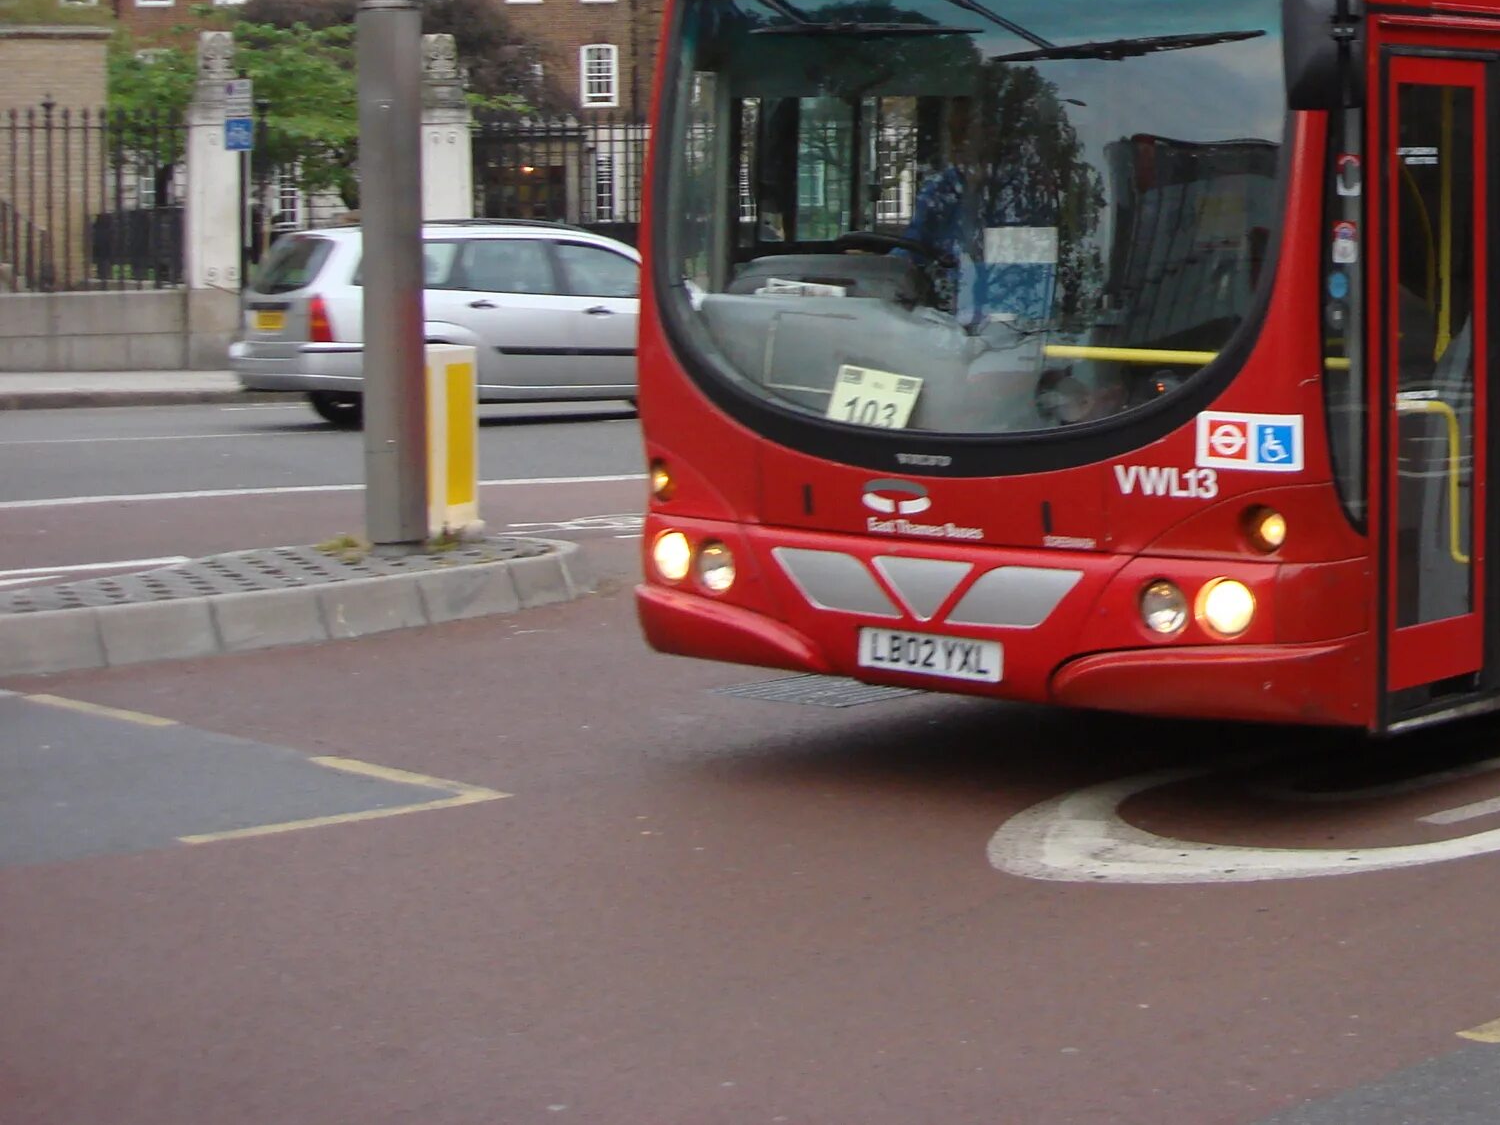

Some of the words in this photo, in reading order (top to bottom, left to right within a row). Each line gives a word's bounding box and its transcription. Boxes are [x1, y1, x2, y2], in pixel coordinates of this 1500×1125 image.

[844, 396, 897, 428] 103
[1113, 464, 1219, 499] VWL13
[867, 516, 896, 532] East
[896, 519, 944, 535] Thames
[944, 523, 984, 539] Buses
[870, 632, 937, 669] LB02
[941, 640, 990, 675] YXL
